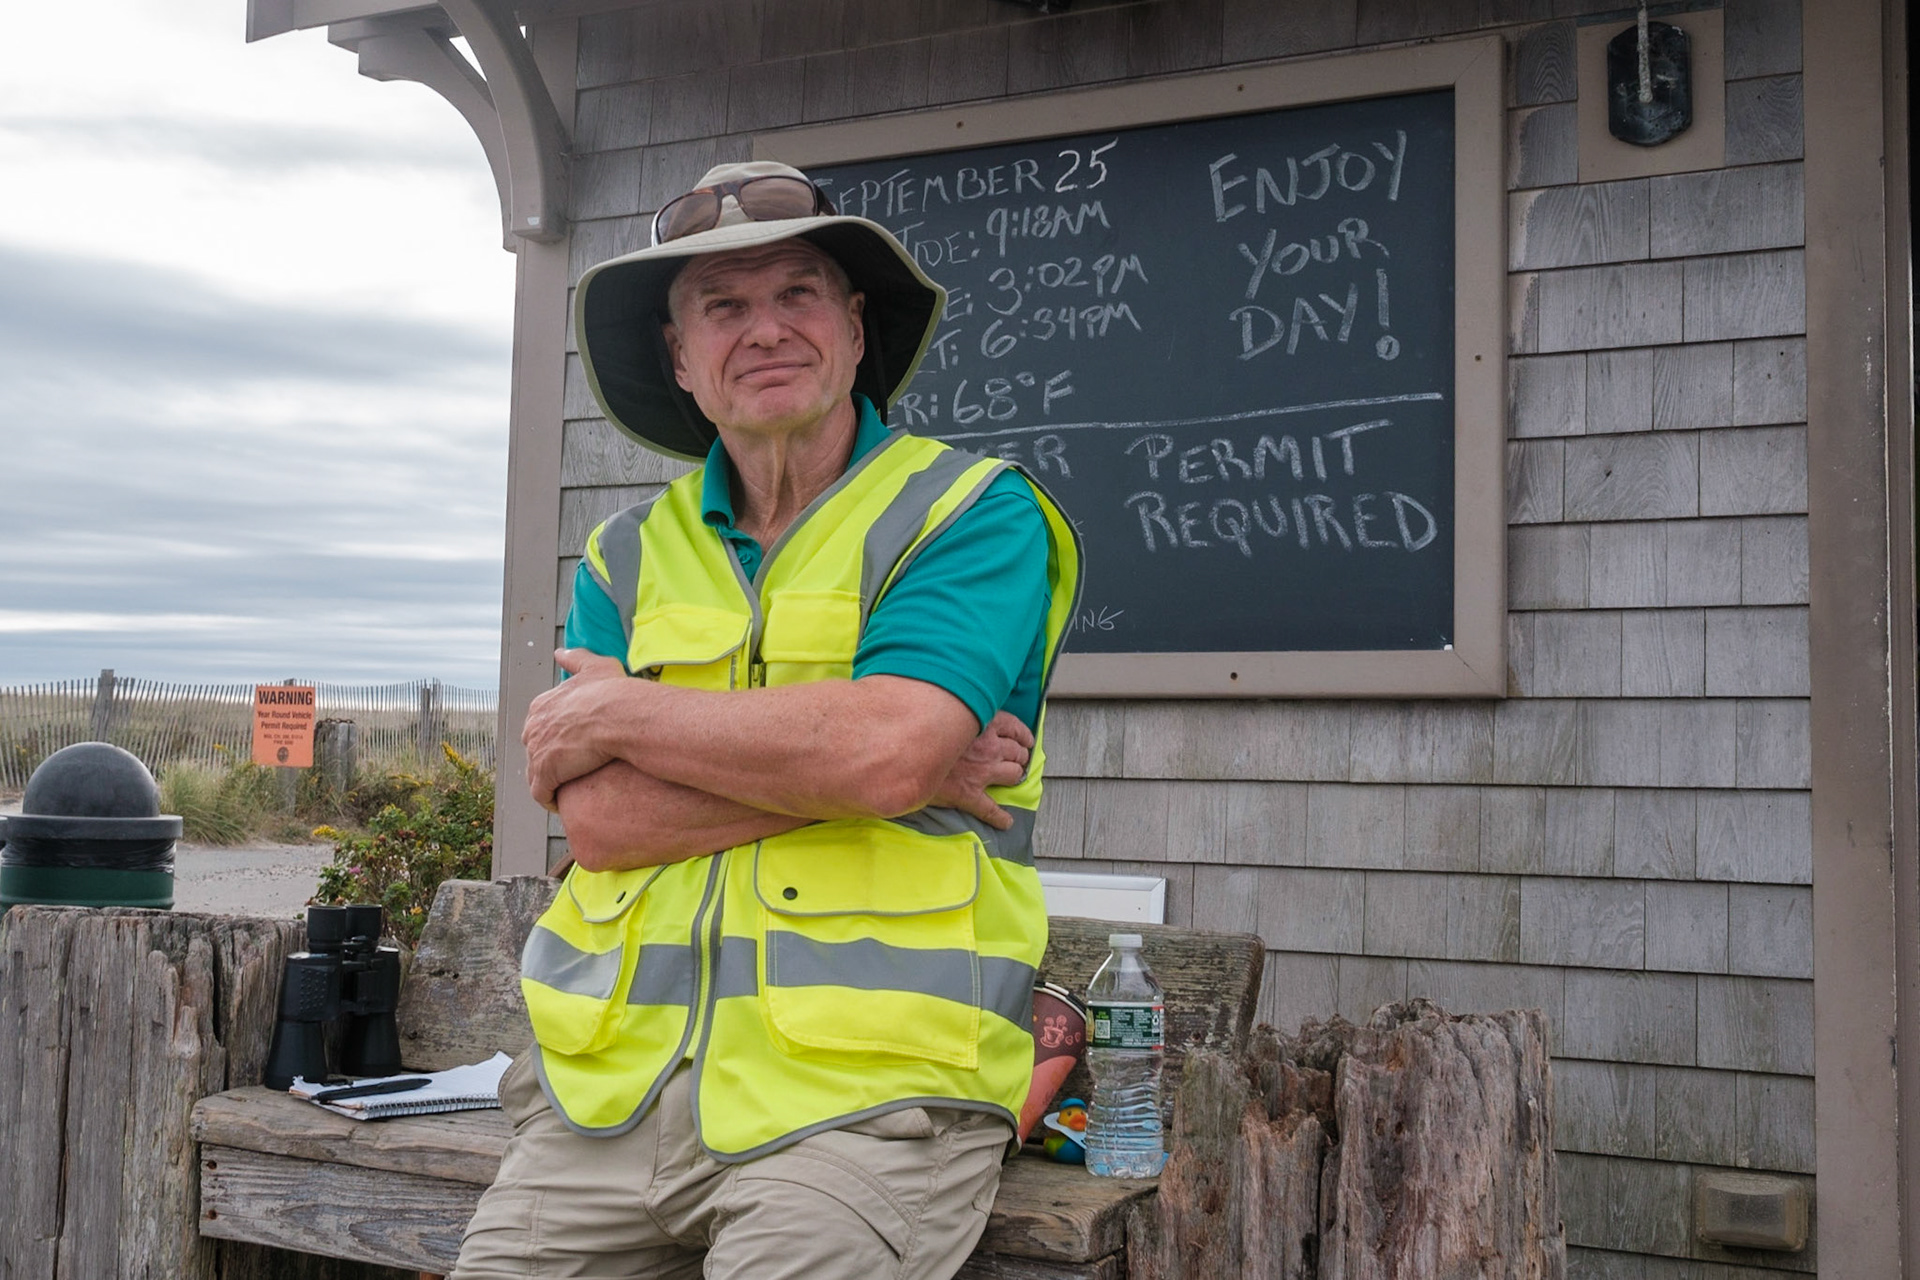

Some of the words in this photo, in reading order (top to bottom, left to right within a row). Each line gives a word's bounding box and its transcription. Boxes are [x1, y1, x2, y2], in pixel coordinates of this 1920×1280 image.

[1055, 137, 1119, 194] 25
[1209, 129, 1407, 223] ENJOY
[986, 200, 1111, 259] 9:18AM
[1237, 216, 1390, 300] YOUR
[986, 254, 1149, 316] 3:02PM
[1228, 267, 1401, 361] DAY!
[980, 302, 1143, 359] 6:34PM
[1124, 418, 1394, 484] PERMIT
[1124, 490, 1438, 557] REQUIRED
[257, 711, 270, 719] Year
[271, 711, 291, 720] Round
[292, 711, 312, 720] Vehicle
[258, 690, 313, 706] WARNING
[261, 721, 281, 729] Permit
[282, 722, 307, 731] Required
